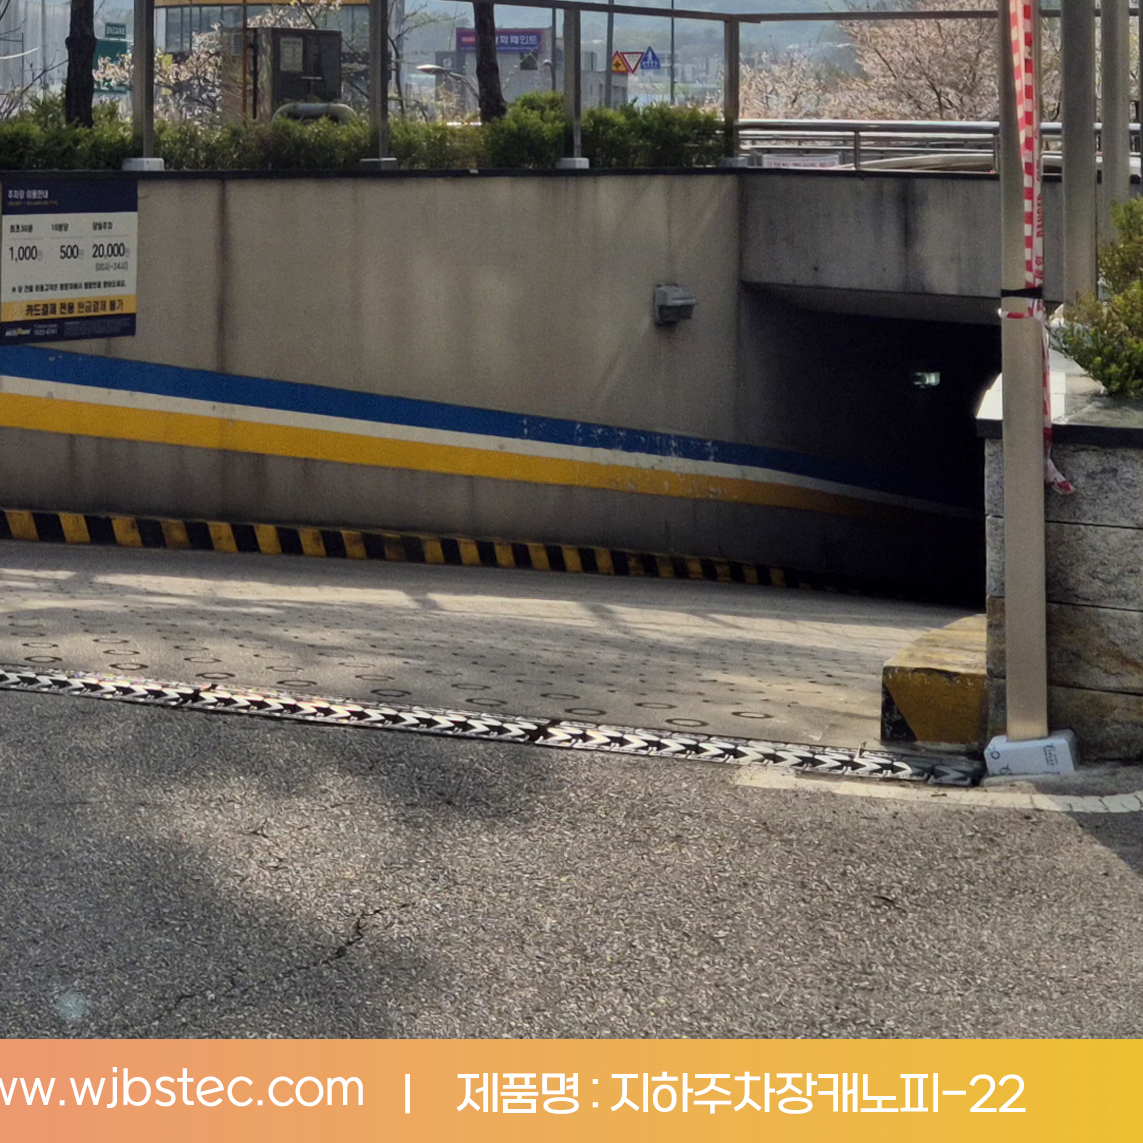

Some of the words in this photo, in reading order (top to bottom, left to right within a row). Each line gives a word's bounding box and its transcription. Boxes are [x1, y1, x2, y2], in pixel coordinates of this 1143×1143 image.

[25, 302, 57, 316] 카드결제
[60, 301, 75, 315] 전용
[77, 300, 107, 314] 현금결제
